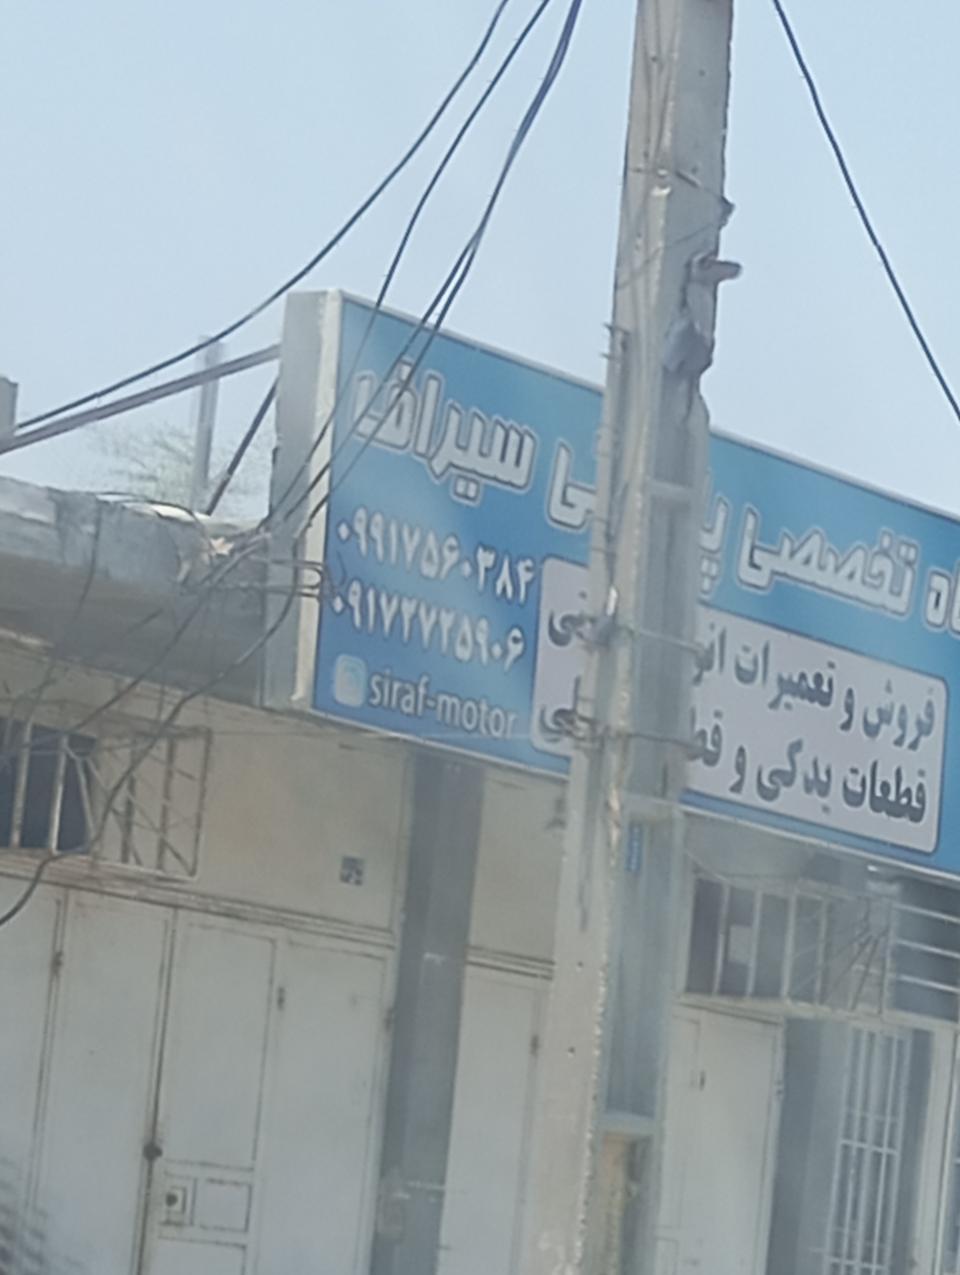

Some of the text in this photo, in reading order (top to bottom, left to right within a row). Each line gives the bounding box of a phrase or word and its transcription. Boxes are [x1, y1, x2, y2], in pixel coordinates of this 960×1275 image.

[353, 360, 537, 502] سیراف
[336, 506, 535, 605] ۰۹۹۱۷۵۶۰۳۸۴
[737, 506, 916, 618] تخصصی
[370, 670, 517, 740] siraf-motor
[734, 641, 837, 711] تعمیرات
[839, 687, 856, 732] و
[862, 679, 936, 751] فروش
[728, 744, 747, 795] و
[756, 738, 832, 815] یدکی
[842, 759, 928, 824] قطعات
